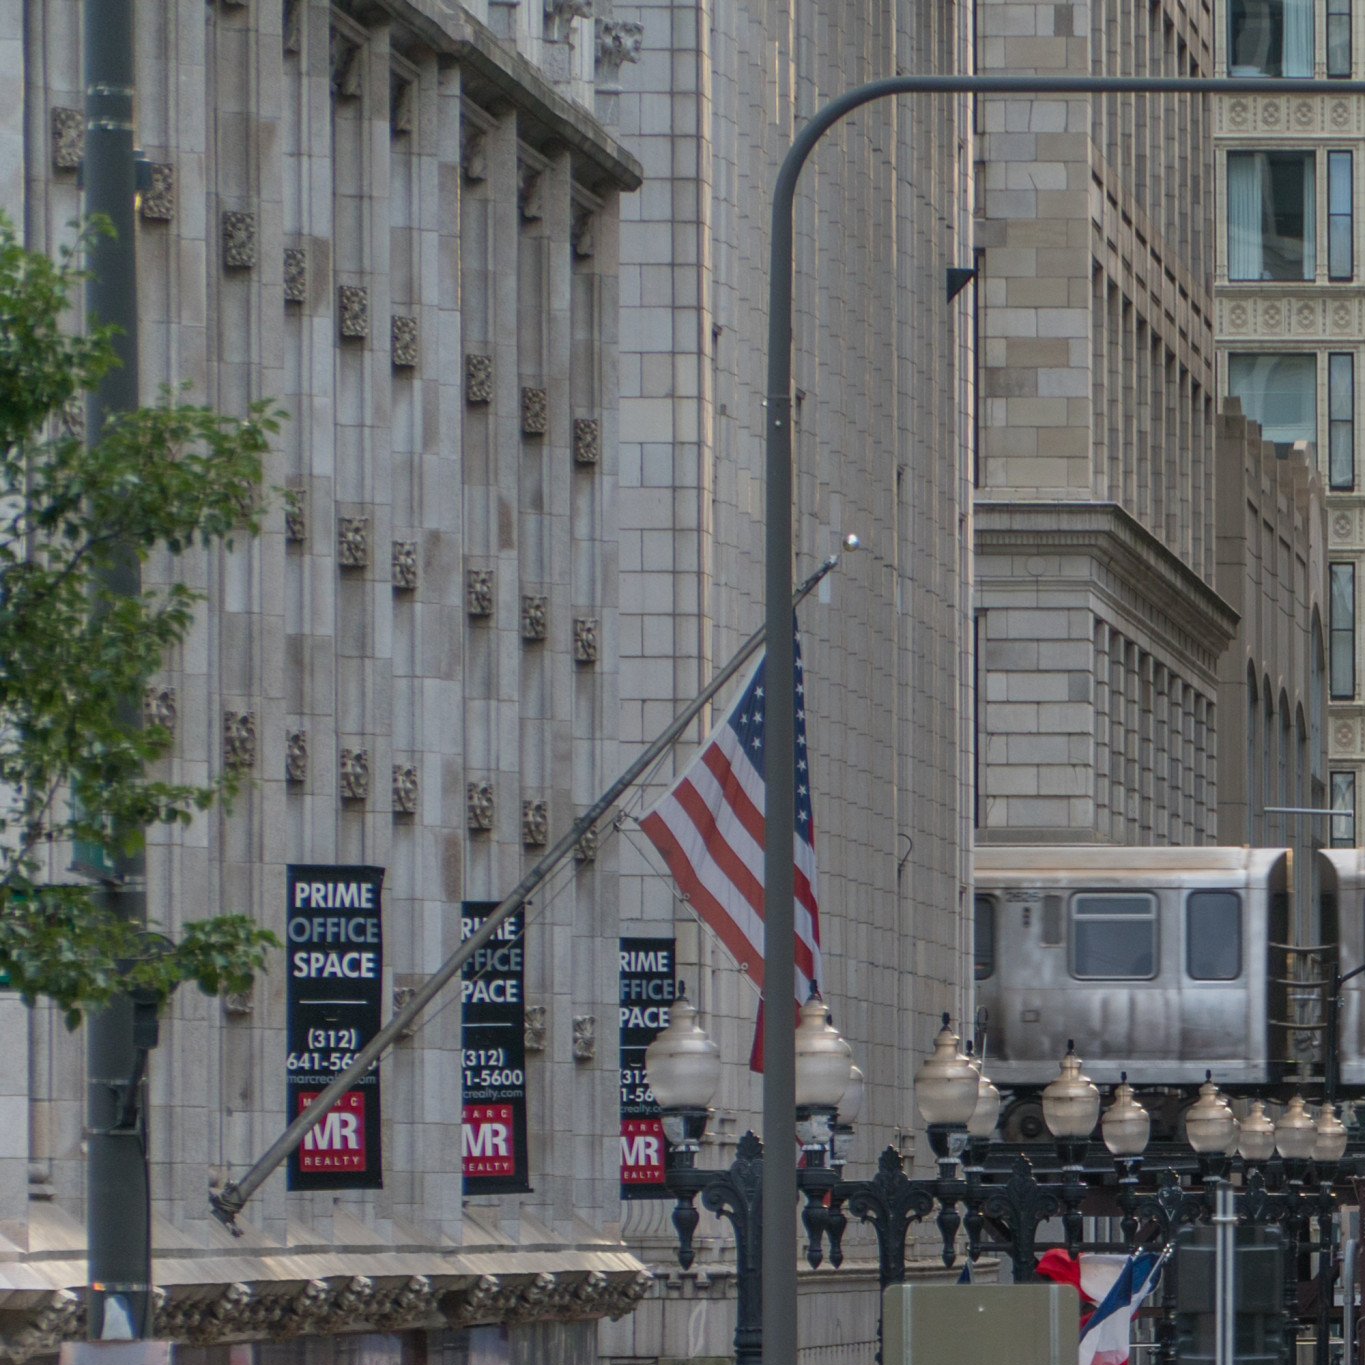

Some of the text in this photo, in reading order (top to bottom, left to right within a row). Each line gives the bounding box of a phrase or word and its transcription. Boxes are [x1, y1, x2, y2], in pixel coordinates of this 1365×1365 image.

[295, 882, 373, 908] PRIME
[288, 917, 379, 943] OFFICE
[293, 952, 375, 978] SPACE
[619, 951, 669, 972] RIME
[461, 980, 518, 1003] PACE
[620, 979, 674, 1000] FFICE
[619, 1007, 670, 1028] PACE
[308, 1028, 356, 1050] (312)
[461, 1048, 504, 1067] (312)
[464, 1070, 523, 1086] 1-5600
[304, 1112, 360, 1150] MR
[461, 1123, 509, 1157] MR
[305, 1156, 360, 1166] REALTY
[619, 1136, 660, 1166] MR
[624, 1171, 660, 1180] EALTY
